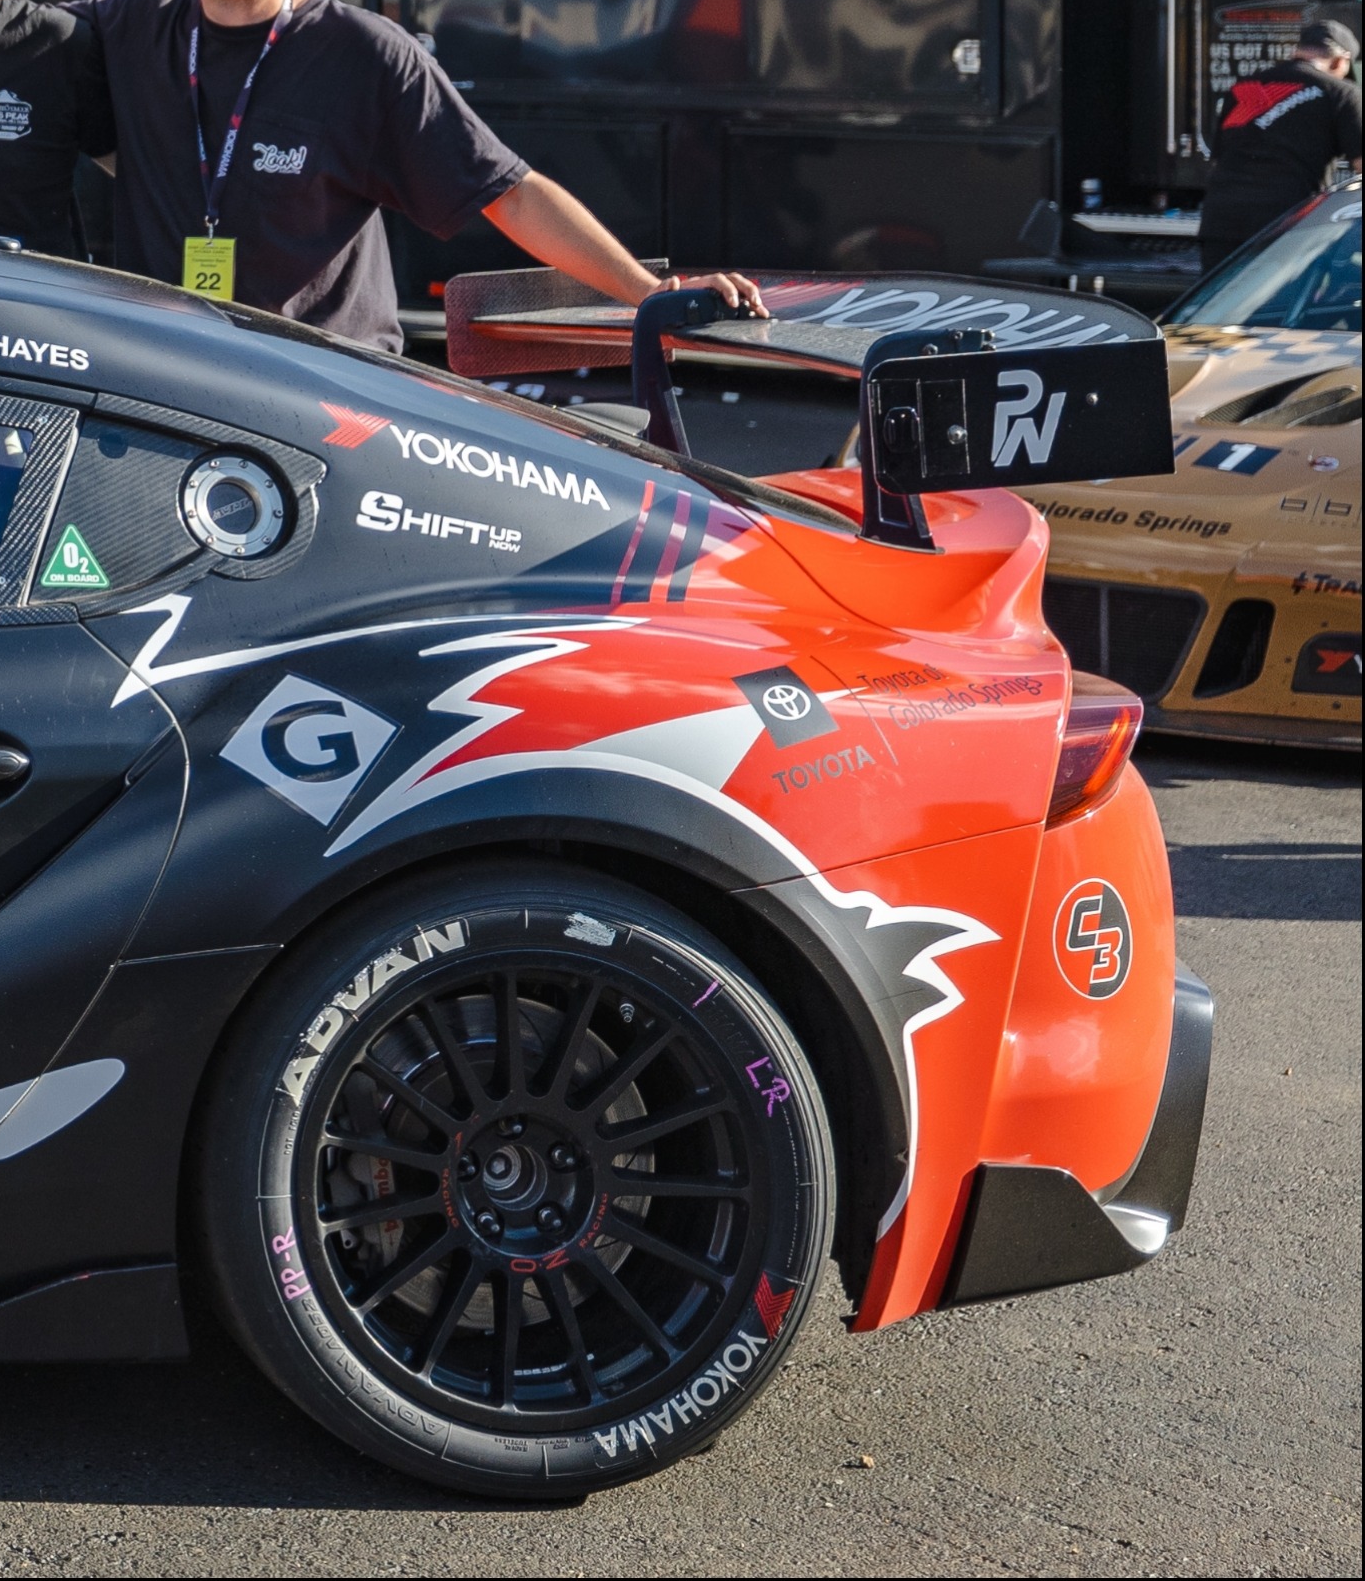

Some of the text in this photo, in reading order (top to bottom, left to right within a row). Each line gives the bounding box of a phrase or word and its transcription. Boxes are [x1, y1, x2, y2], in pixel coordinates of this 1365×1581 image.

[195, 272, 221, 290] 22
[389, 424, 611, 511] YOKOHAMA
[356, 490, 522, 545] SHIFT UP
[1134, 509, 1233, 539] Springs
[488, 539, 521, 553] NOW
[49, 573, 100, 583] ON BOARD
[1314, 574, 1362, 594] TRA
[857, 663, 949, 698] Toyota of
[888, 677, 1044, 731] Colorado Springs
[261, 700, 359, 782] G
[772, 744, 877, 795] TOYOTA
[275, 920, 467, 1107] ADVAN
[271, 1226, 314, 1301] PP-R
[339, 1353, 446, 1436] ADVAN
[596, 1327, 769, 1459] YOKOHAMA
